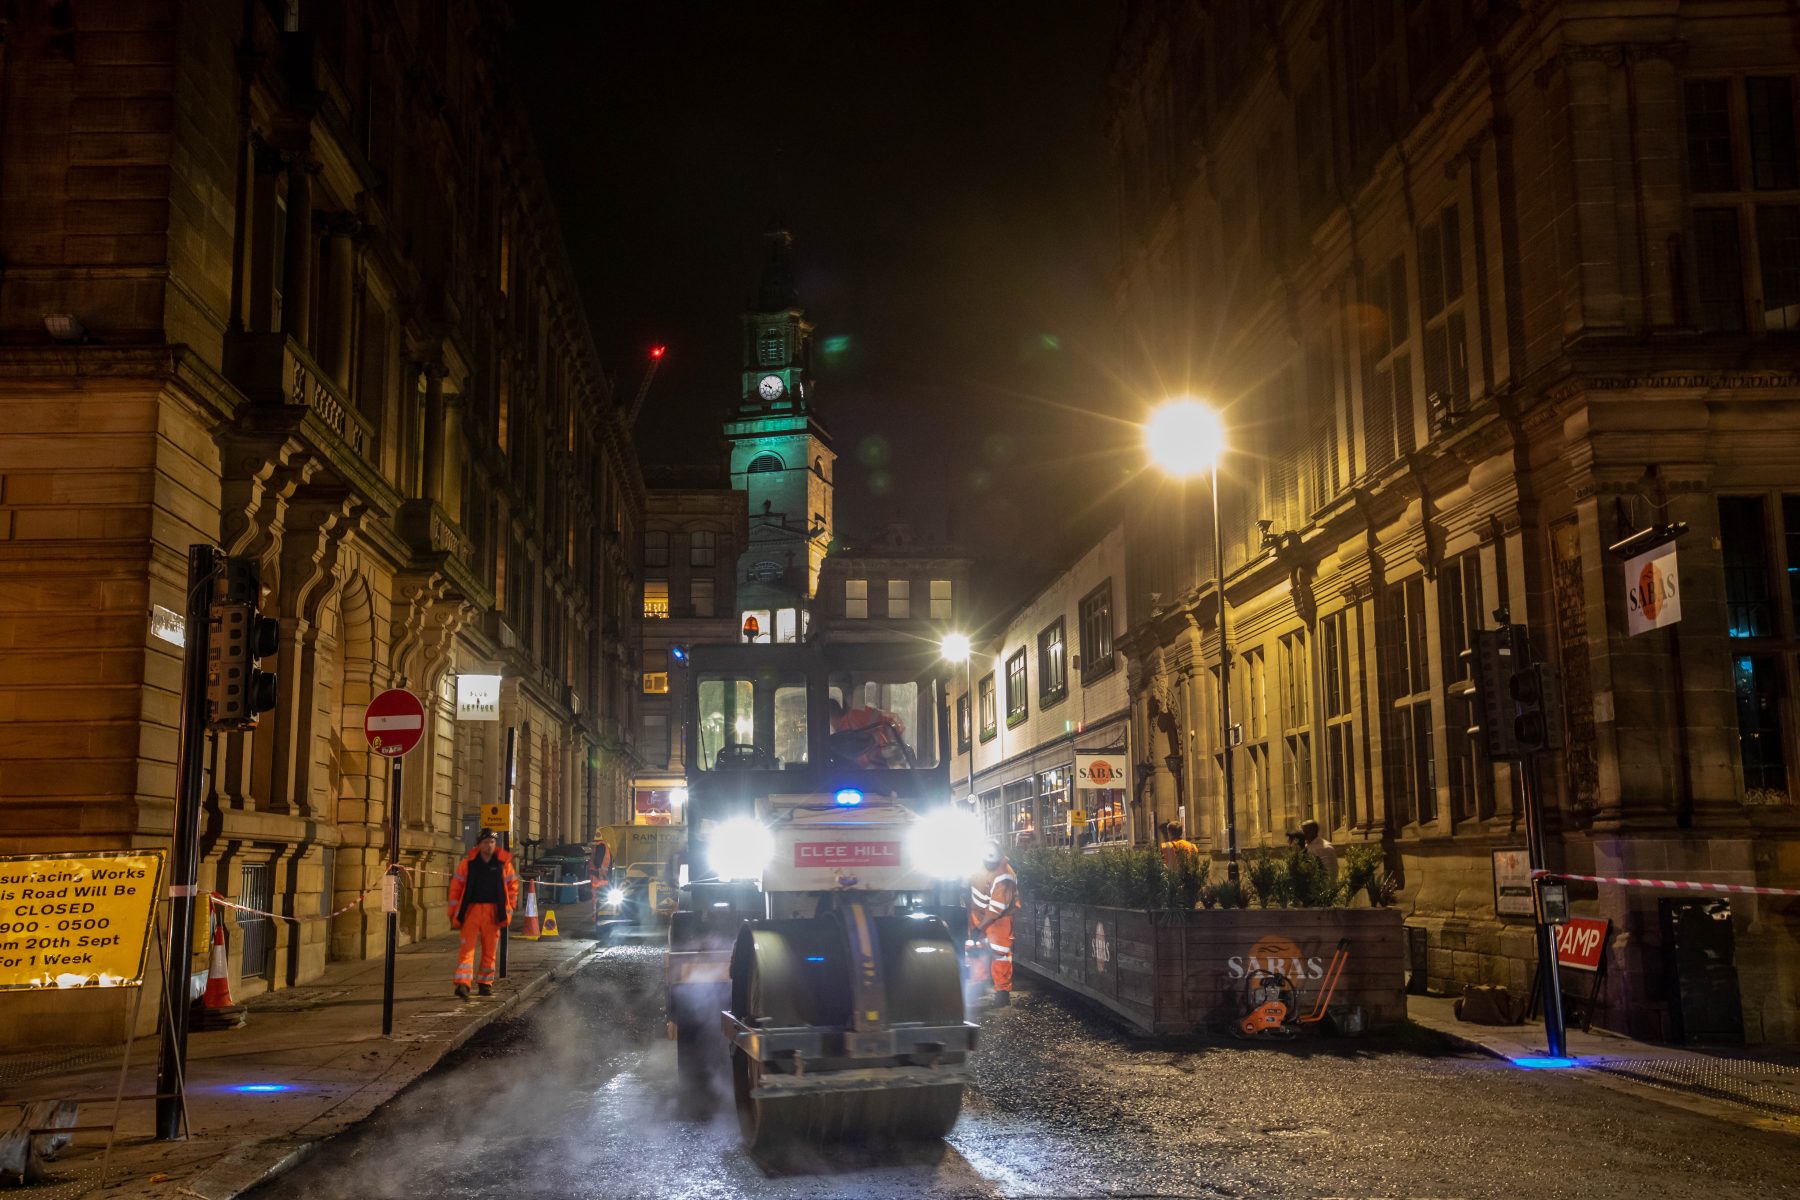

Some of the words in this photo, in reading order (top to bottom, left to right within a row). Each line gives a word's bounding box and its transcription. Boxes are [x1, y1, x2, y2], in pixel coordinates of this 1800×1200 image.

[1629, 573, 1676, 612] SABAS
[462, 704, 494, 712] LETTUCE
[1079, 767, 1123, 779] SABAS
[801, 846, 847, 857] CLEE
[854, 845, 894, 856] HILL
[91, 868, 145, 880] Works
[1, 890, 15, 900] is
[22, 888, 68, 899] Road
[74, 886, 107, 897] Will
[114, 885, 136, 896] Be
[15, 903, 95, 916] CLOSED
[57, 918, 110, 931] 0500
[0, 941, 19, 950] m
[26, 937, 70, 949] 20th
[77, 935, 120, 948] Sept
[1556, 925, 1600, 957] RAMP
[30, 956, 36, 966] 1
[44, 953, 92, 965] Week
[1228, 956, 1323, 979] SABAS
